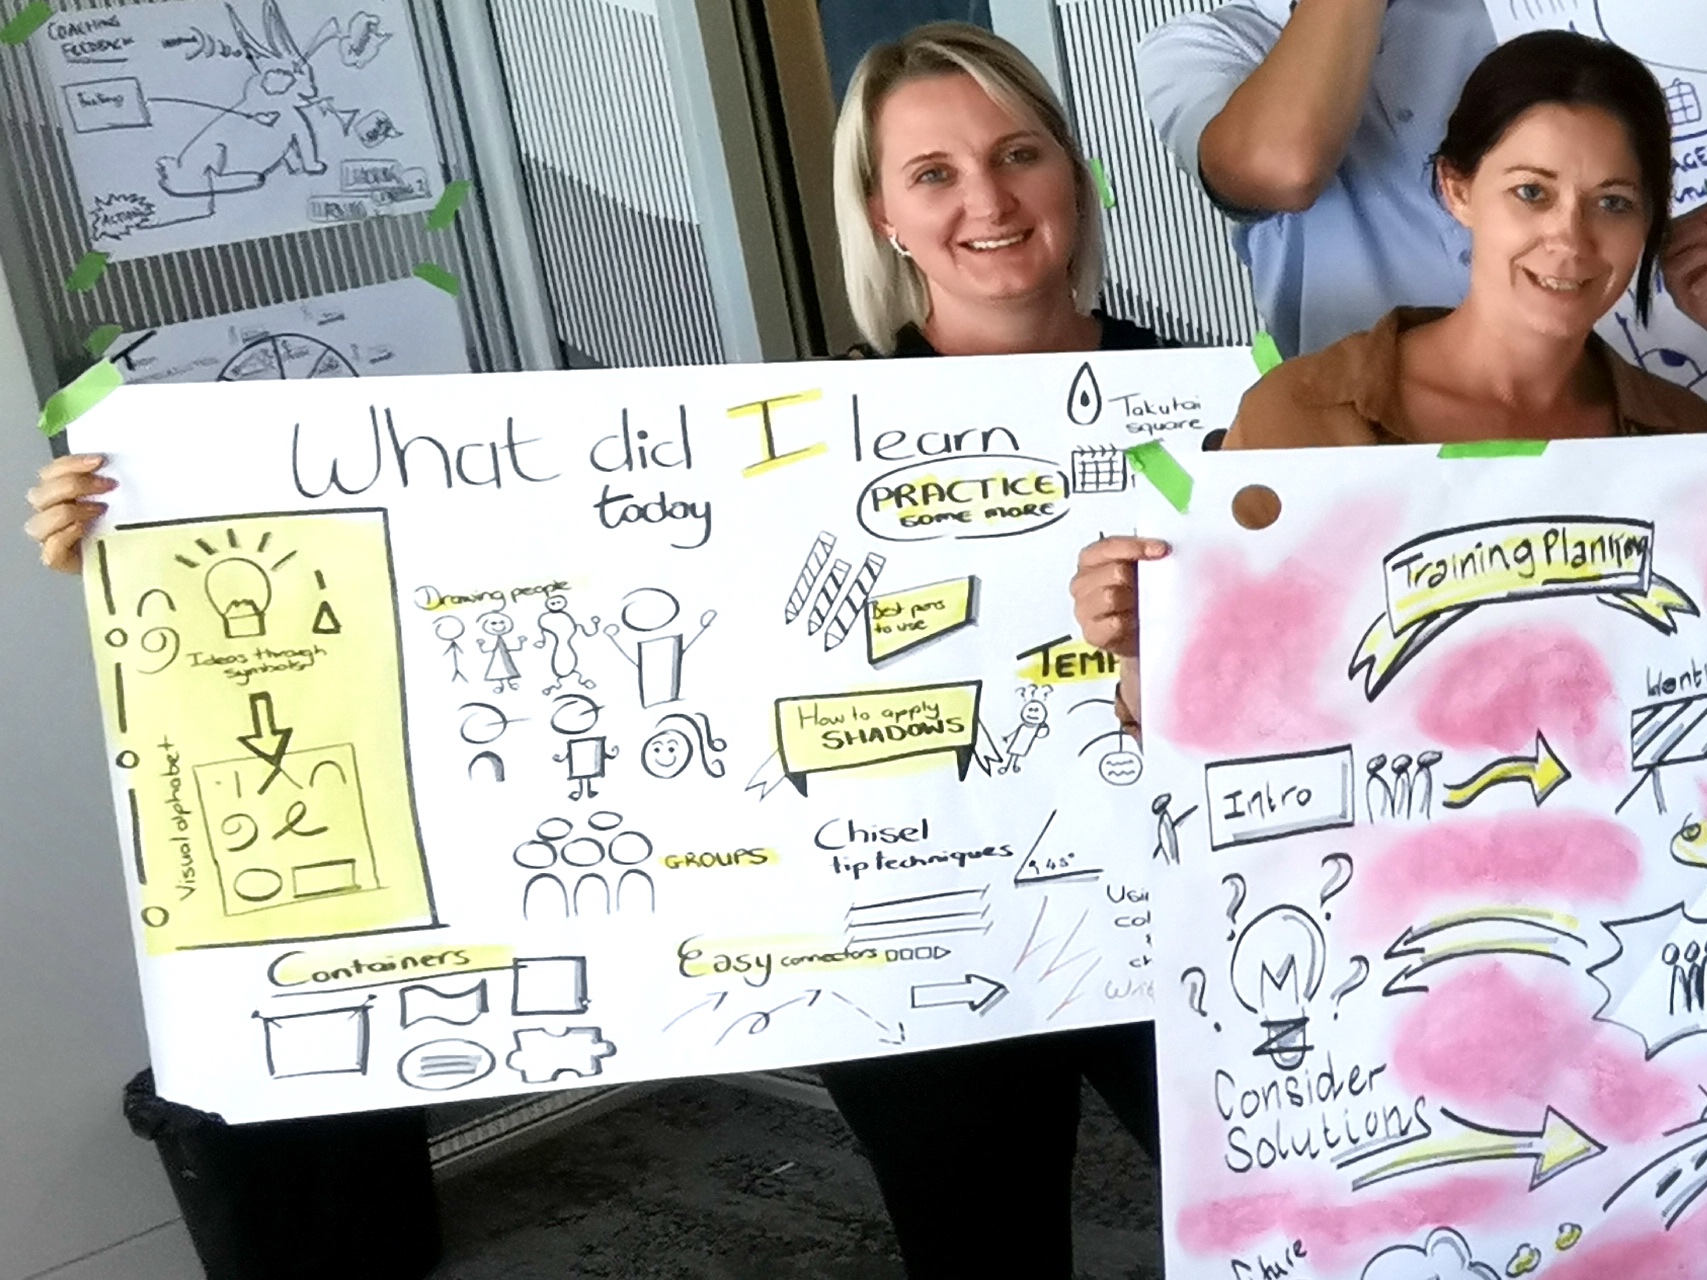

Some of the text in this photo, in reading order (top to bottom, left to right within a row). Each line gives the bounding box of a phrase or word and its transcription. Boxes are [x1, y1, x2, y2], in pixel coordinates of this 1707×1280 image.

[293, 388, 1020, 499] What did I learn
[1125, 417, 1204, 436] square
[870, 475, 1056, 512] PRACTICE
[593, 484, 713, 549] today
[984, 503, 1055, 521] MORE
[1391, 537, 1536, 589] Training
[414, 580, 573, 613] Drawing people
[871, 600, 903, 620] Best
[872, 619, 929, 634] to use
[187, 646, 328, 667] Ideas through
[798, 700, 941, 730] How to apply
[821, 716, 966, 751] SHADOWS
[1223, 780, 1313, 821] Intro
[813, 818, 929, 850] Chisel
[664, 847, 769, 870] GROUPS
[832, 842, 1014, 880] tip techniques
[266, 947, 472, 987] Containers
[677, 933, 879, 987] Easy connectors
[1214, 1050, 1388, 1121] Consider
[1224, 1094, 1432, 1174] Solutions
